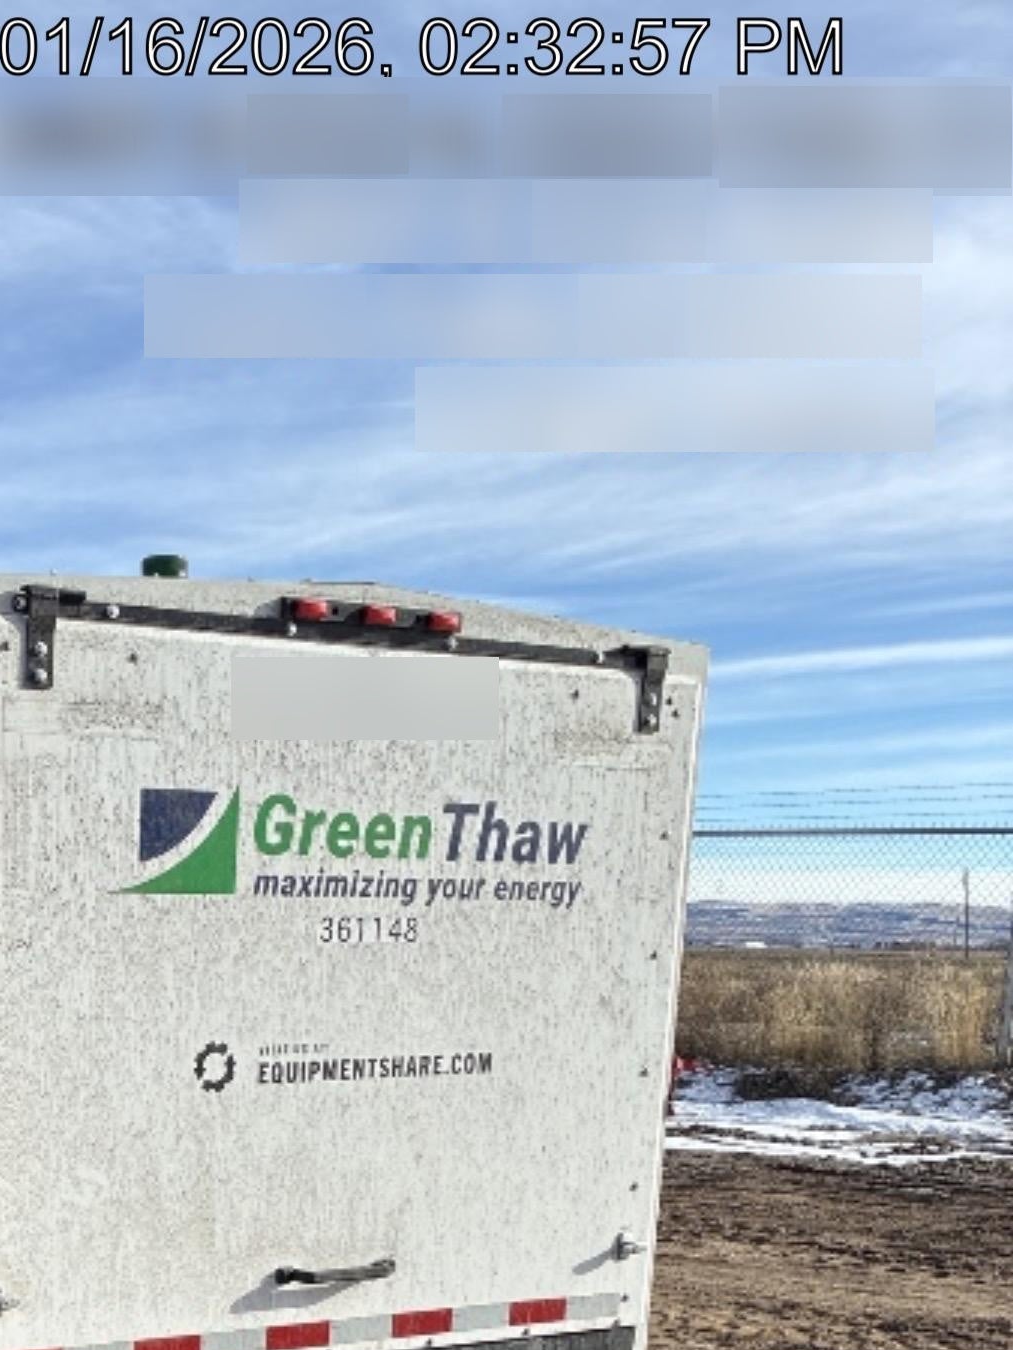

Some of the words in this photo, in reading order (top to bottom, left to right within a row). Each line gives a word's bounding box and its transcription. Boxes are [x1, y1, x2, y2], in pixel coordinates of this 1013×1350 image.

[252, 868, 418, 907] maximizing
[424, 876, 486, 907] your
[492, 876, 583, 910] energy
[319, 917, 419, 944] 361148
[257, 1052, 493, 1085] EQUIPMENTSHARE.COM
